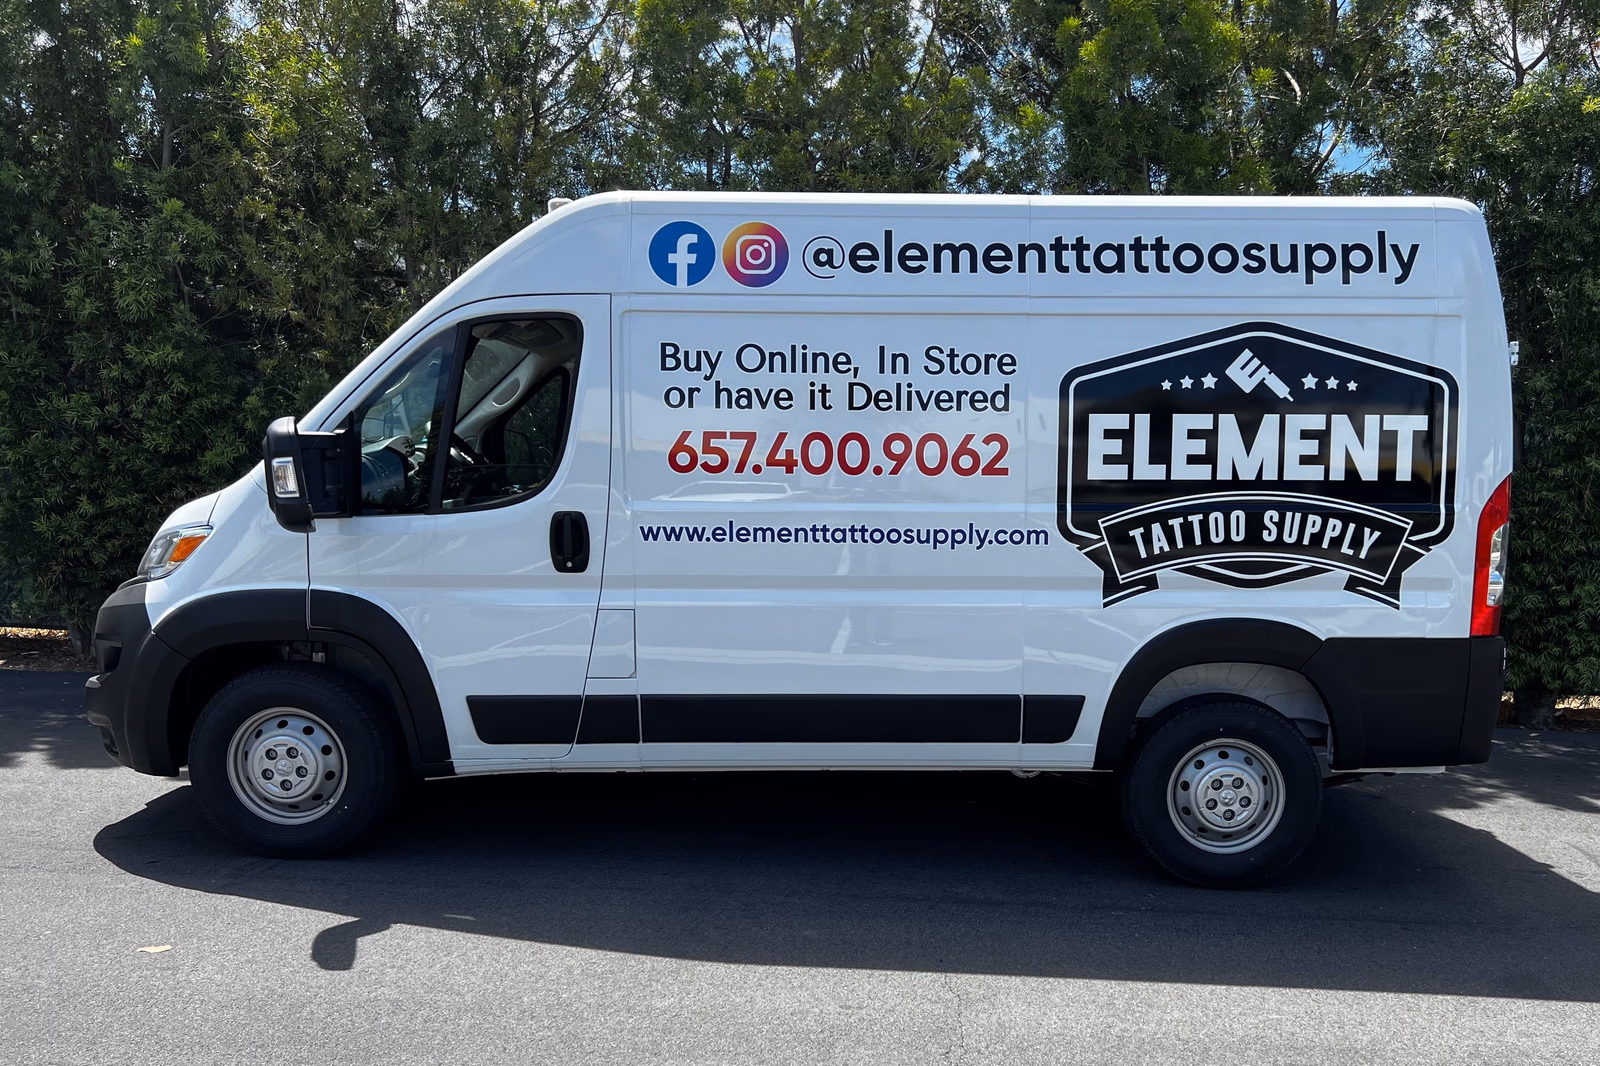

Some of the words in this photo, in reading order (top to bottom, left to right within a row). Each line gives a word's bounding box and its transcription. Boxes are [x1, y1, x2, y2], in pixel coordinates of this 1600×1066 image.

[802, 229, 1420, 285] @elementtattoosupply
[660, 342, 723, 381] Buy
[735, 343, 860, 379] Online,
[878, 345, 909, 375] In
[923, 345, 1017, 376] Store
[663, 384, 701, 409] or
[714, 380, 794, 411] have
[808, 381, 832, 411] it
[847, 381, 1011, 413] Delivered
[667, 430, 1010, 477] 657.400.9062
[1087, 413, 1428, 482] ELEMENT
[640, 521, 1049, 550] www.elementtattoosupply.com
[1129, 510, 1245, 560] TATTOO
[1262, 510, 1382, 560] SUPPLY
